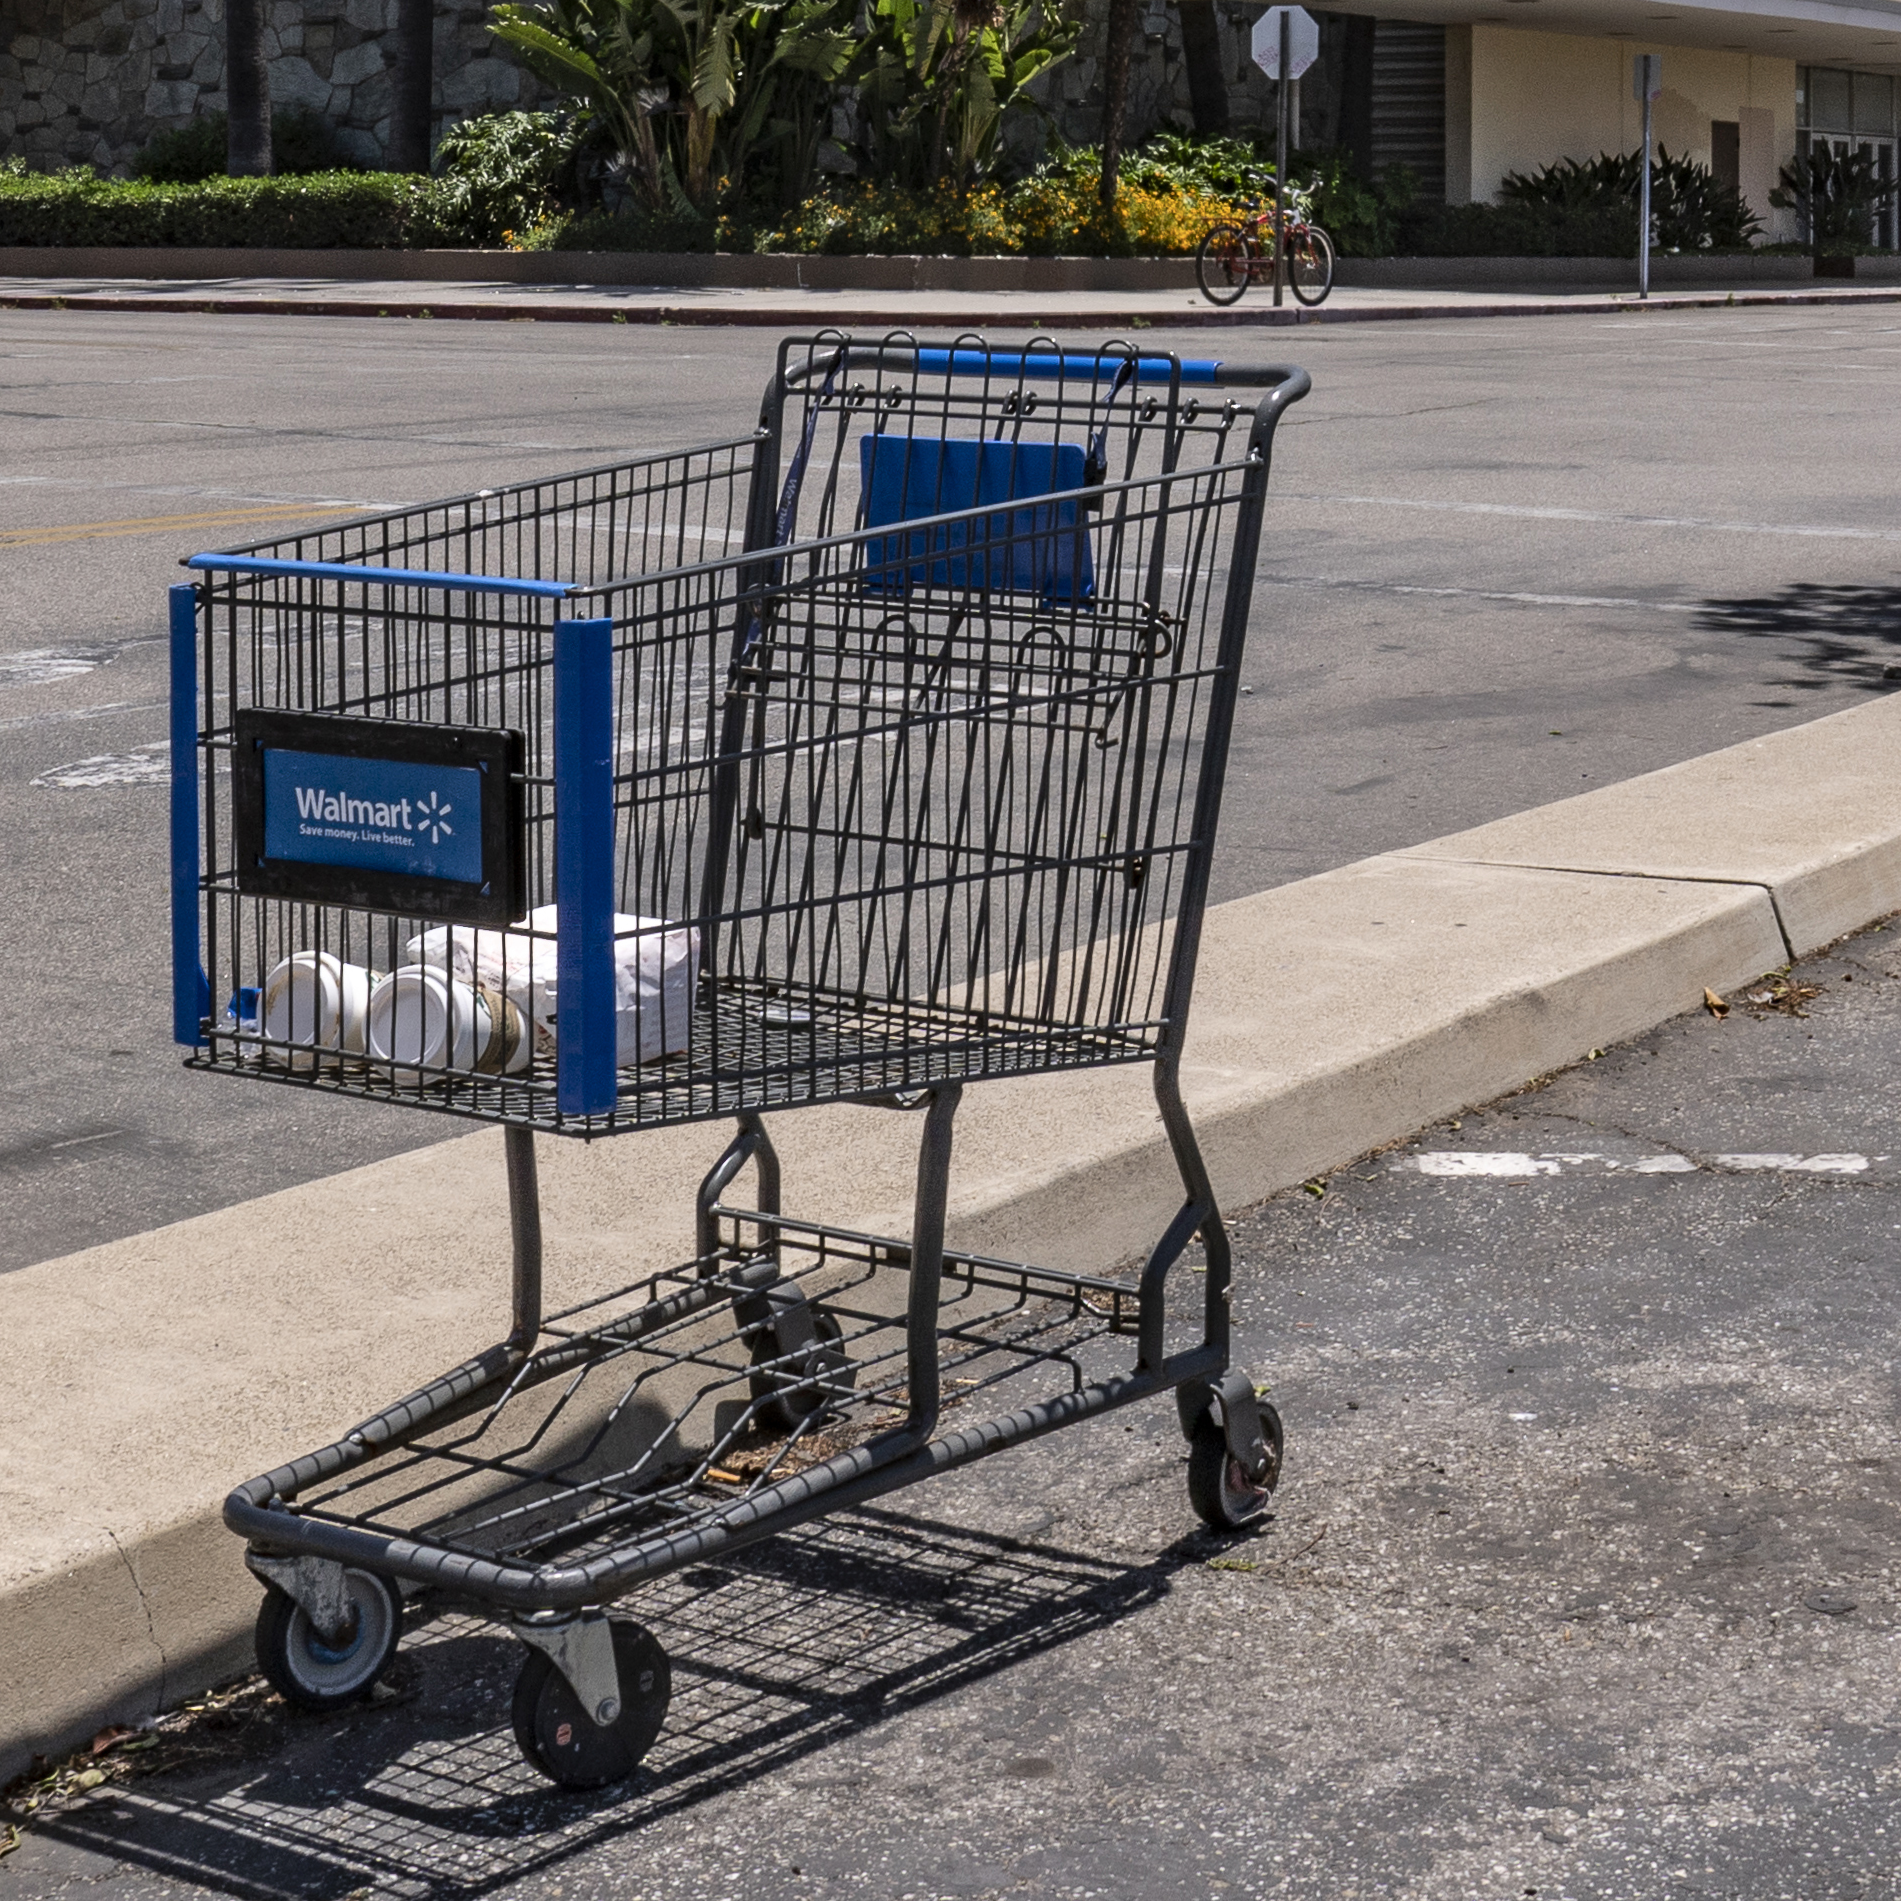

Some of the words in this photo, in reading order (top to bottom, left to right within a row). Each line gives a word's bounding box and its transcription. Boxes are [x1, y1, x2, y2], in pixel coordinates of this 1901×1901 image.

[776, 478, 798, 536] Wamart
[295, 787, 413, 830] Walmart
[299, 823, 323, 837] Save
[324, 828, 360, 842] money.
[361, 830, 382, 843] Live
[383, 832, 415, 847] better.
